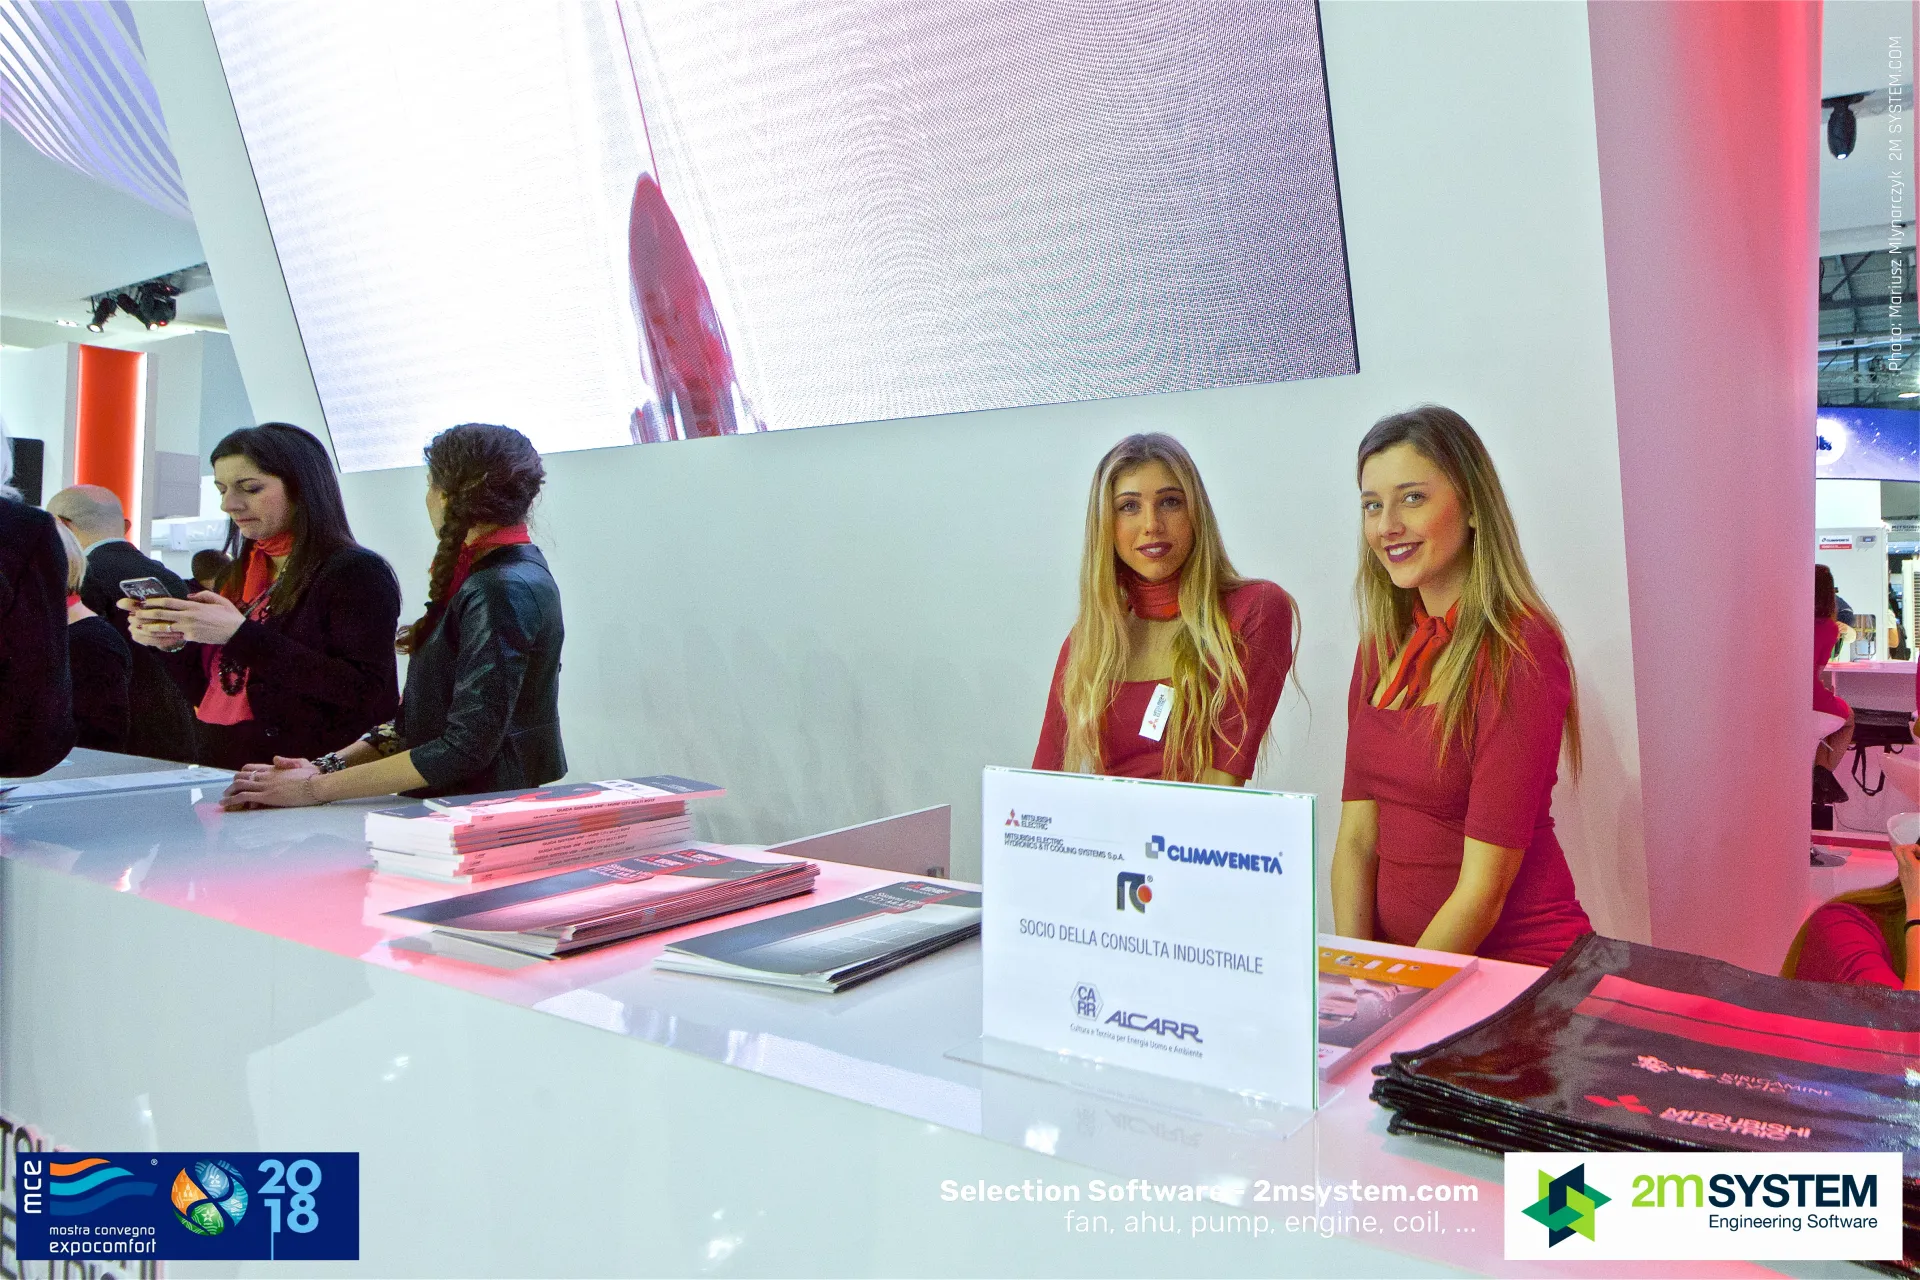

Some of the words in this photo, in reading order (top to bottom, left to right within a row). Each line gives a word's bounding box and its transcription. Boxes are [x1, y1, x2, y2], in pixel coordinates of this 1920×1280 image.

[1021, 814, 1052, 823] MITSUBISHI
[1021, 821, 1048, 830] ELECTRIC
[1004, 832, 1035, 842] MITSUBISHI
[1036, 836, 1063, 846] ELECTRIC
[1004, 840, 1037, 850] HYDRONICS
[1050, 845, 1077, 855] COOLING
[1078, 848, 1106, 858] SYSTEMS
[1167, 845, 1282, 875] CLIMAVENETA
[1019, 918, 1055, 939] SOCIO
[1059, 924, 1098, 947] DELLA
[1101, 932, 1169, 959] CONSULTA
[1173, 943, 1263, 975] INDUSTRIALE
[1070, 1023, 1090, 1035] Cultura
[1096, 1028, 1115, 1040] Tecnica
[1116, 1035, 1126, 1045] per
[1127, 1035, 1149, 1048] Energia
[1150, 1040, 1167, 1051] Uomo
[1174, 1045, 1203, 1059] Ambiente
[1659, 1111, 1789, 1141] ELECTRIC
[1661, 1107, 1811, 1139] MITSUBISHI
